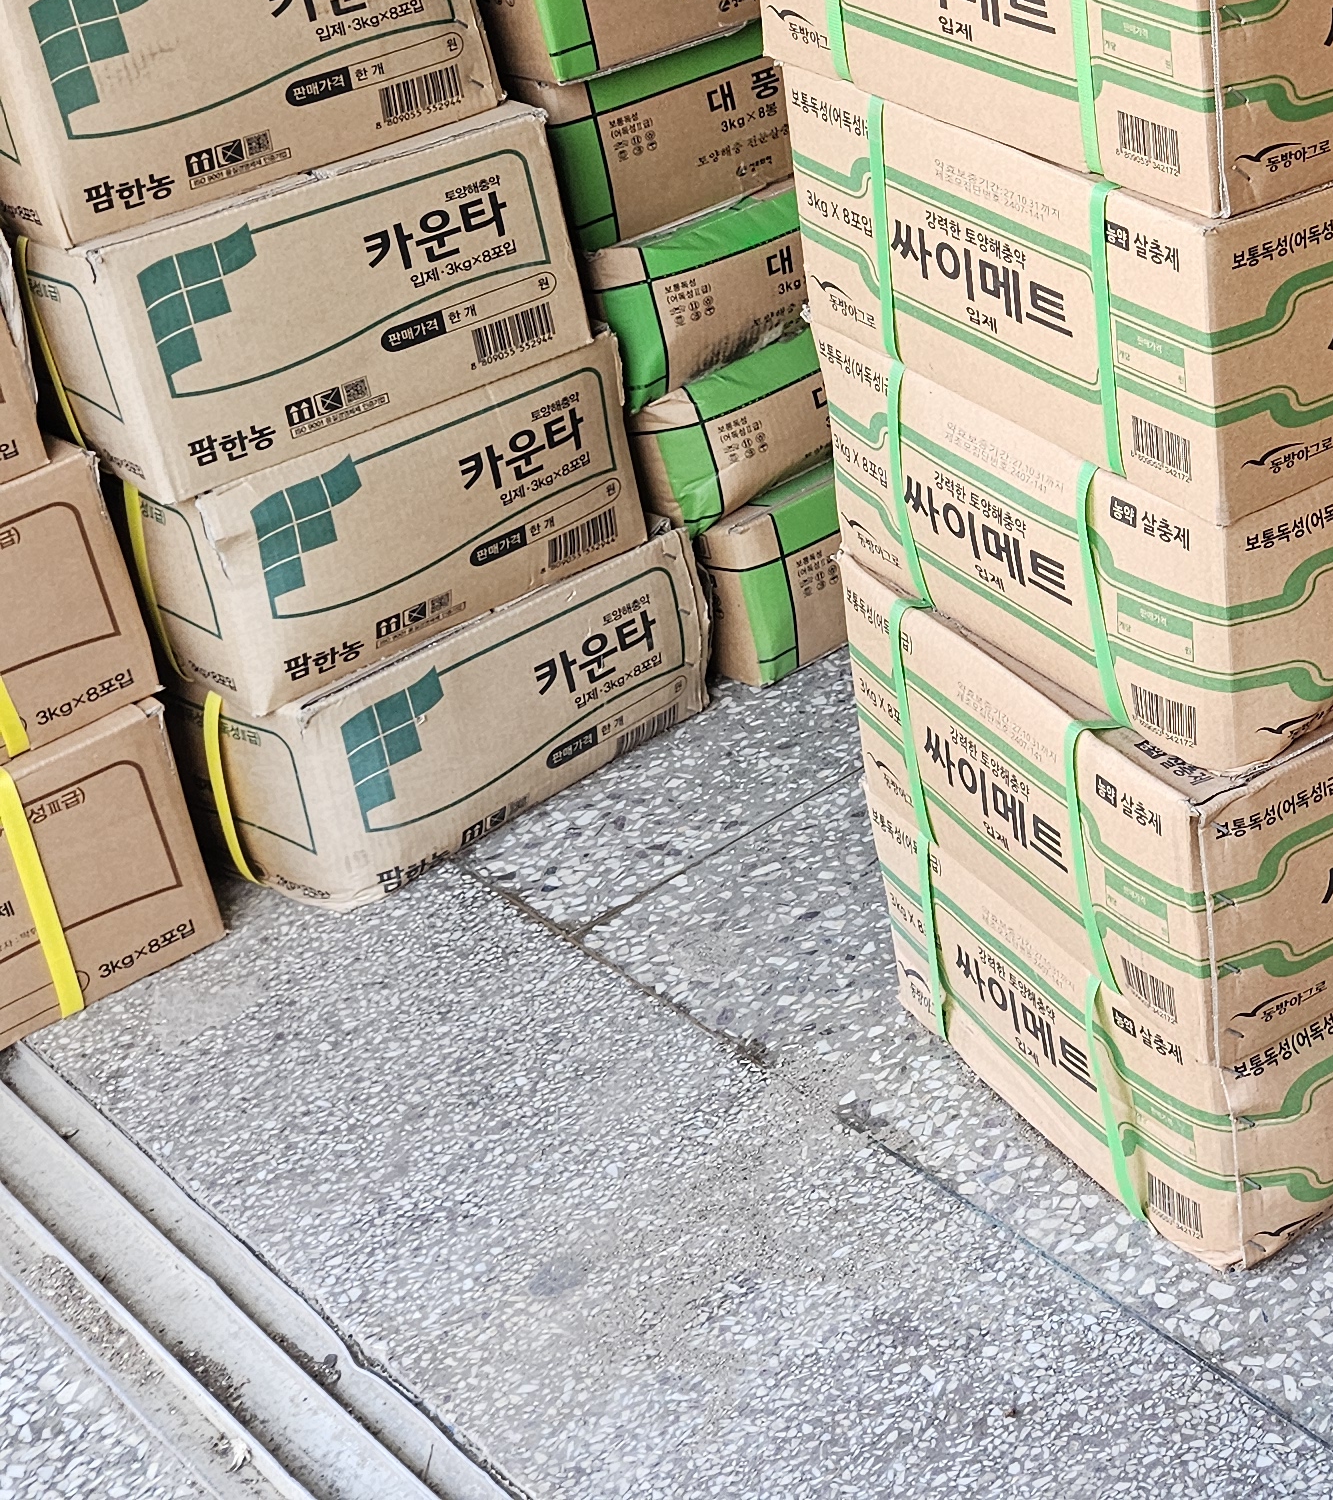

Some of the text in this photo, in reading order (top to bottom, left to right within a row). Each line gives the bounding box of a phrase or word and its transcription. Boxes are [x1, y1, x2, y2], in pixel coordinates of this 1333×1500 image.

[706, 68, 780, 113] 대 풍
[84, 172, 176, 214] 팜한농
[363, 190, 509, 273] 카운타
[891, 218, 1074, 338] 싸이메트
[459, 407, 586, 494] 카운타
[903, 474, 1073, 606] 싸이메트
[533, 610, 657, 700] 카운타
[923, 725, 1070, 873] 싸이메트
